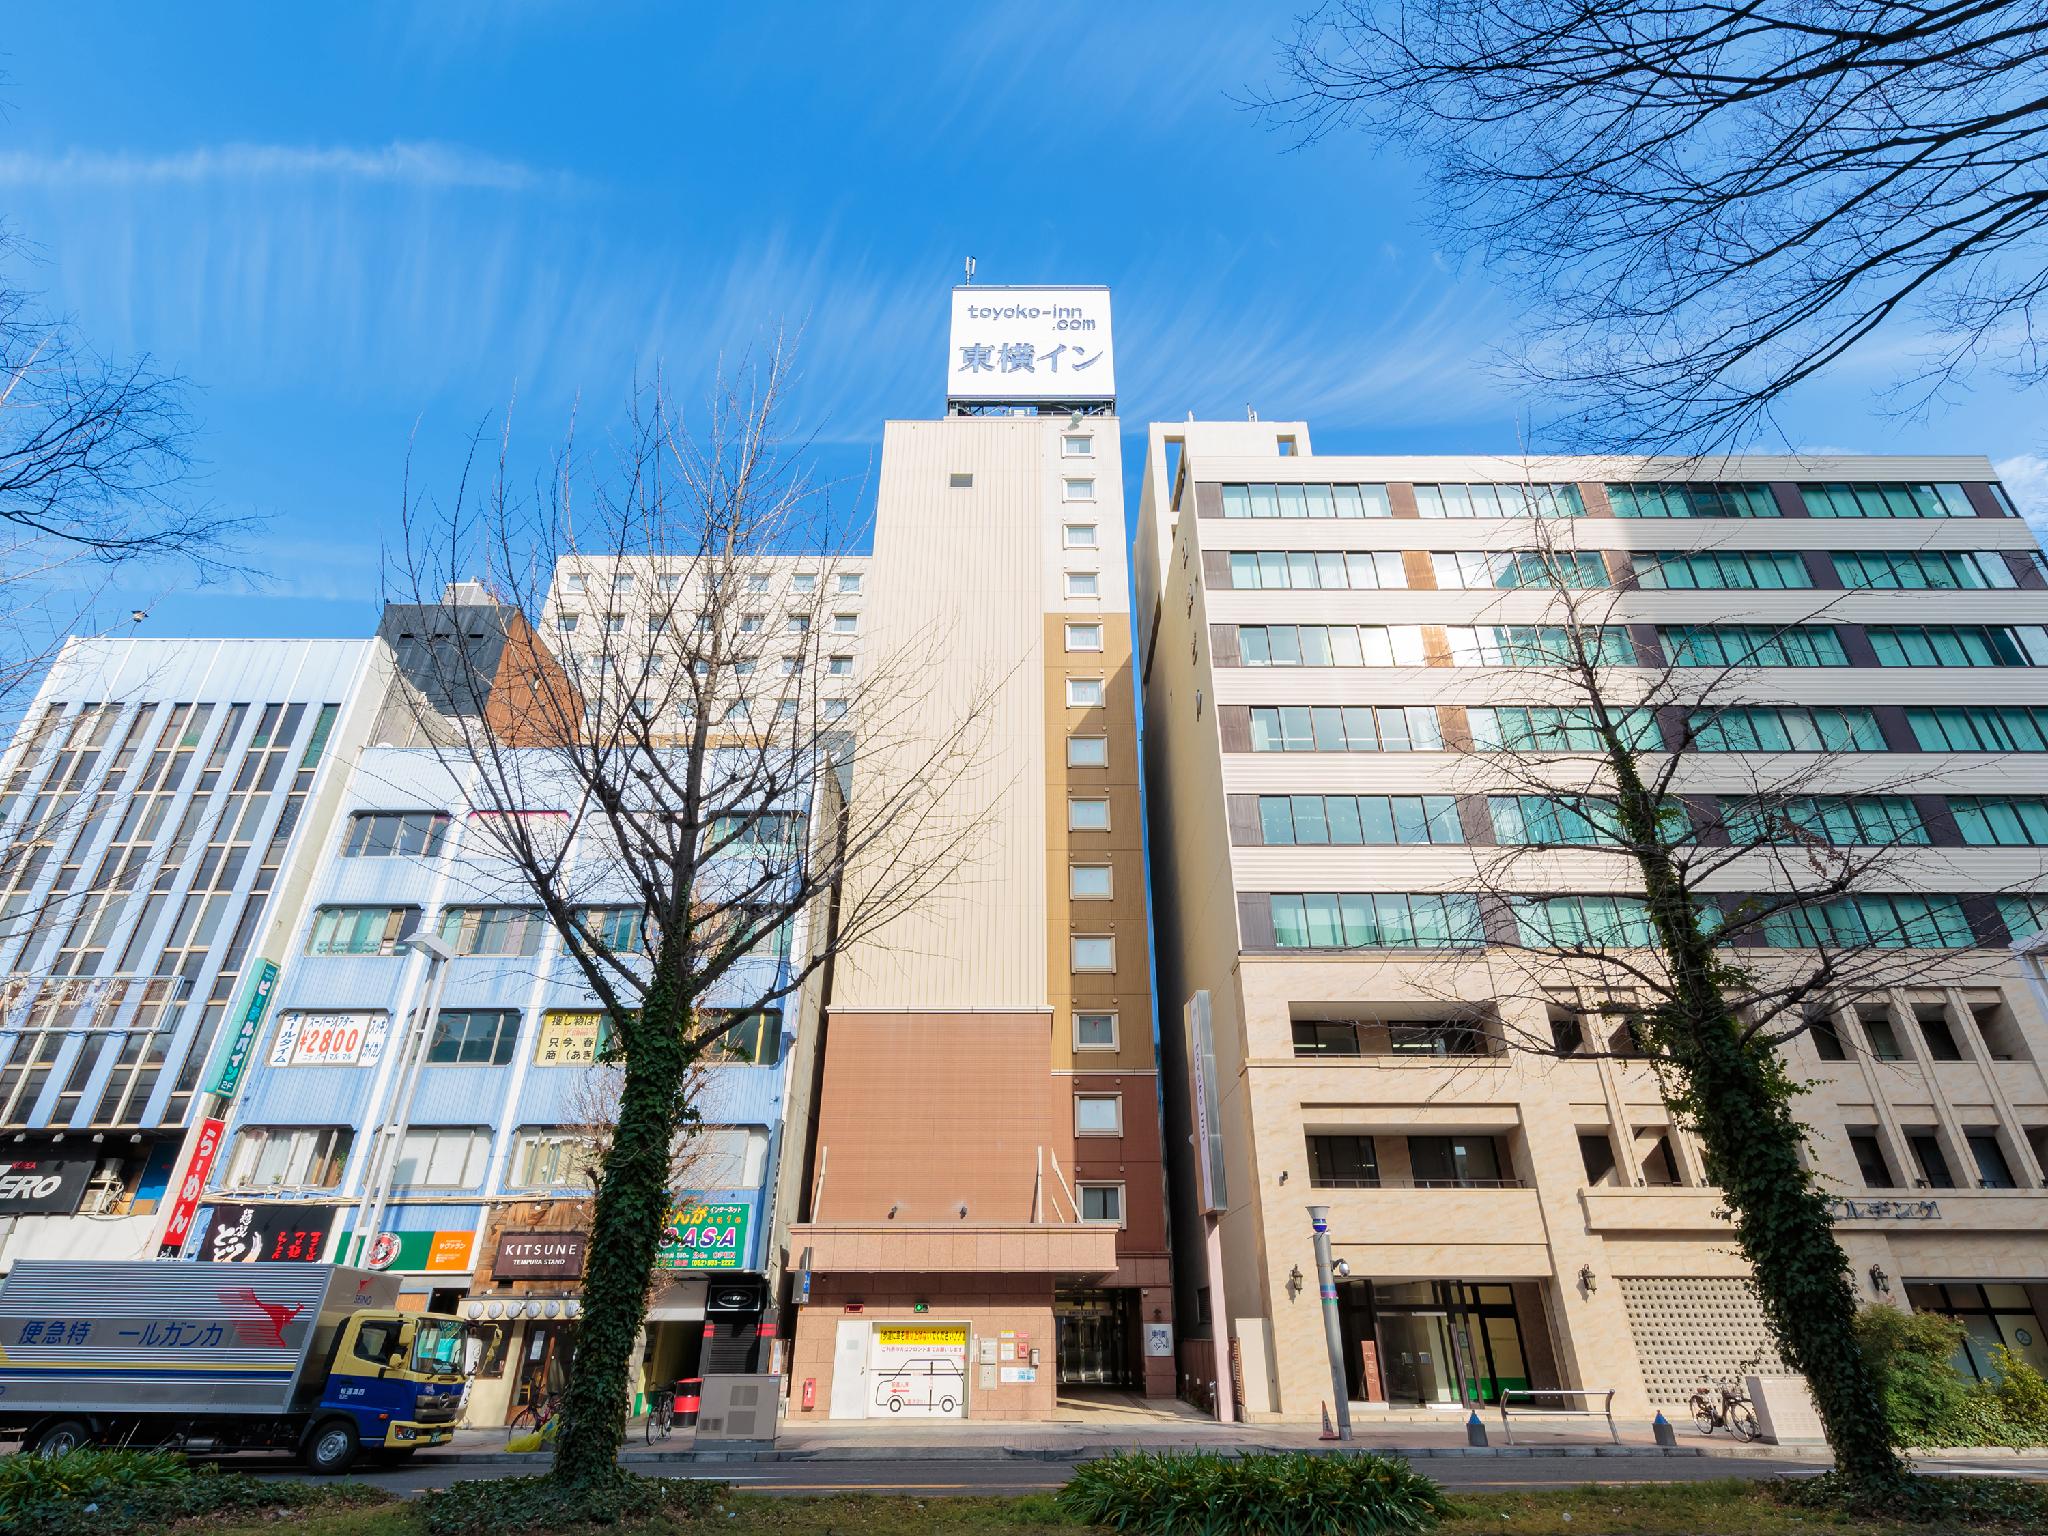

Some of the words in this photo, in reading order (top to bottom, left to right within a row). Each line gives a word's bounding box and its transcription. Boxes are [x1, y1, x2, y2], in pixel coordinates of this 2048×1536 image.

[968, 304, 1082, 320] toyoko-inn
[1052, 319, 1096, 330] .com
[958, 343, 1103, 373] 東横イン
[0, 1167, 62, 1199] ERO
[168, 1127, 217, 1234] らーめん
[505, 1244, 577, 1256] KITSUNE
